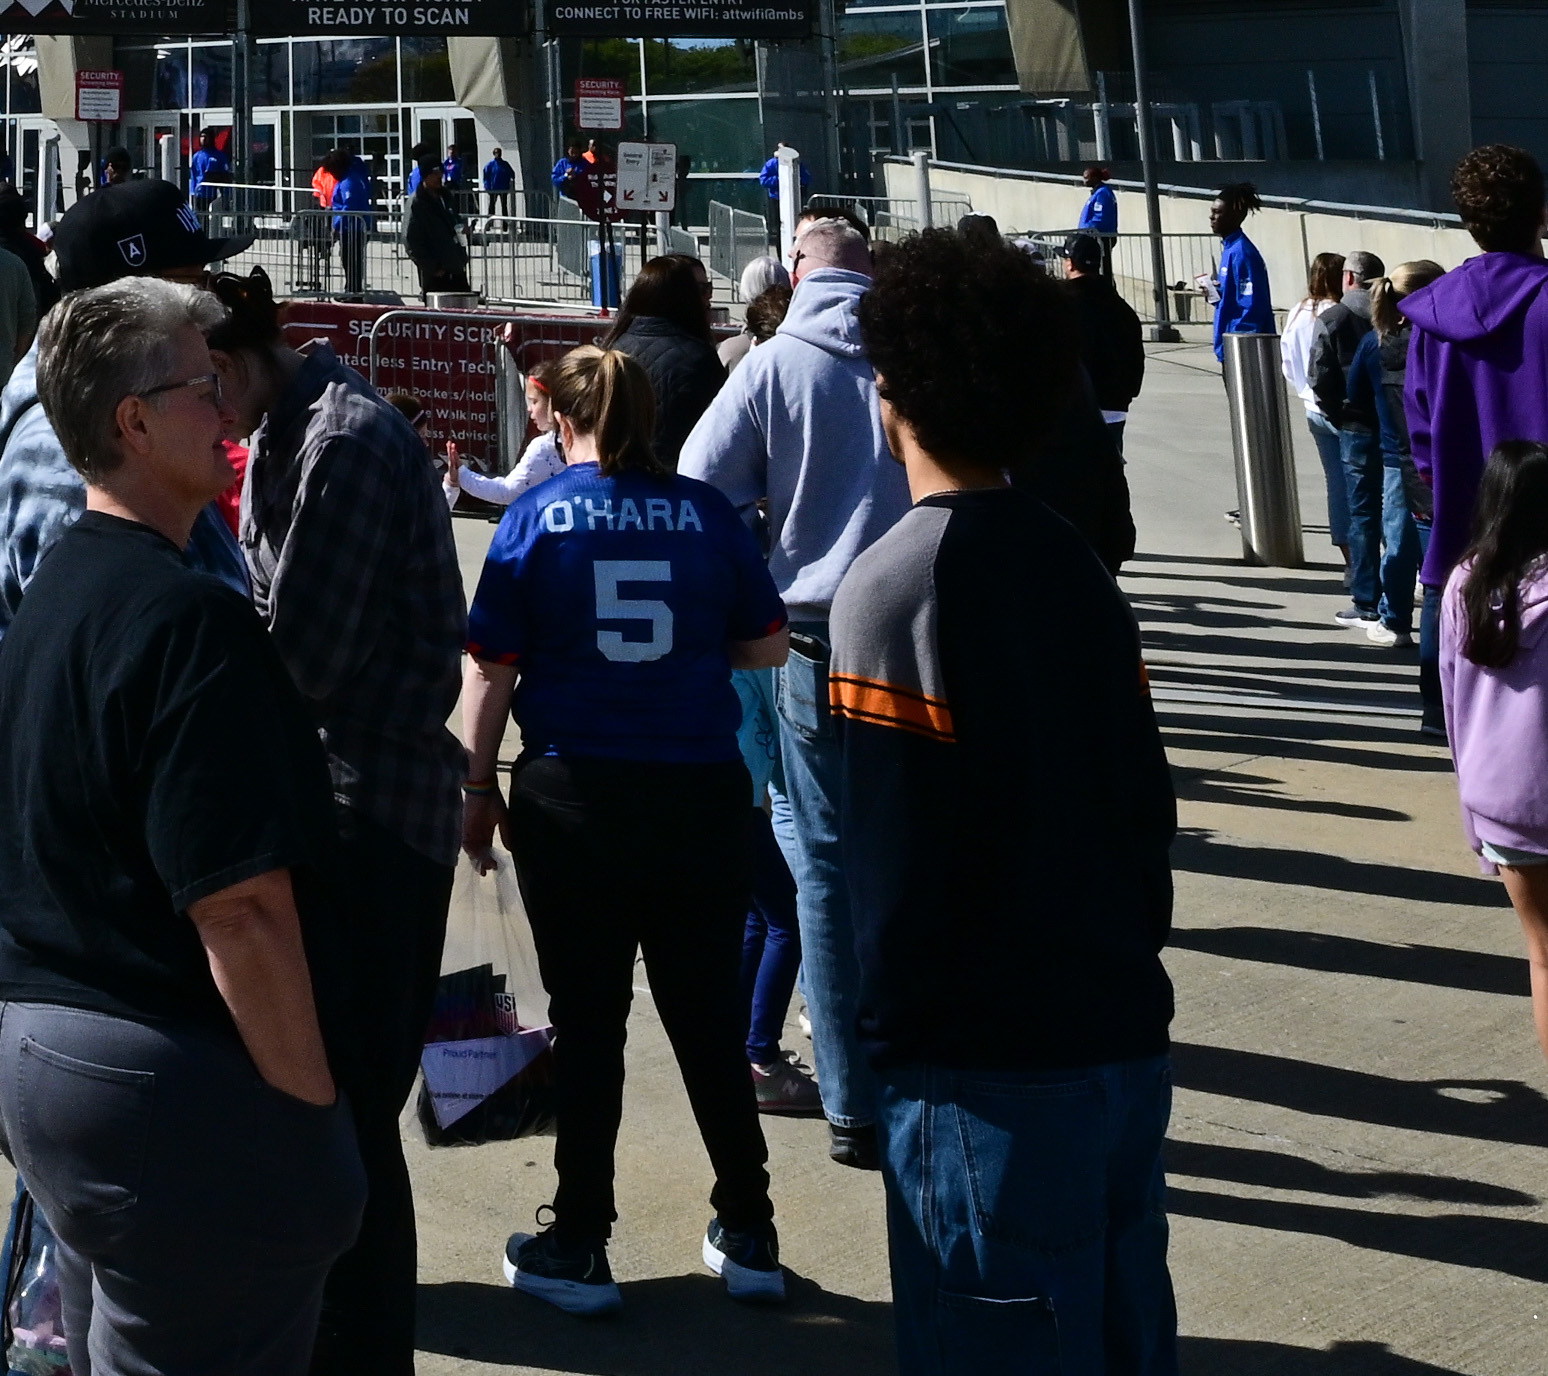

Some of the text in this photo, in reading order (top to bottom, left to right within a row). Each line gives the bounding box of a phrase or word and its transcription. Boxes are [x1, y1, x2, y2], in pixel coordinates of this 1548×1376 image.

[110, 10, 179, 19] STADIUM
[308, 7, 469, 25] READY TO SCAN
[555, 6, 804, 20] CONNECT TO FREE WIFI: attwifi@mbs
[80, 71, 120, 80] SECURITY
[580, 80, 620, 89] SECURITY
[128, 241, 142, 259] A
[349, 320, 446, 341] SECURITY
[412, 357, 453, 374] Entry
[458, 359, 496, 374] Tech
[436, 408, 486, 423] Walkng
[544, 495, 703, 534] O'HARA
[593, 560, 674, 662] 5
[496, 995, 516, 1012] US
